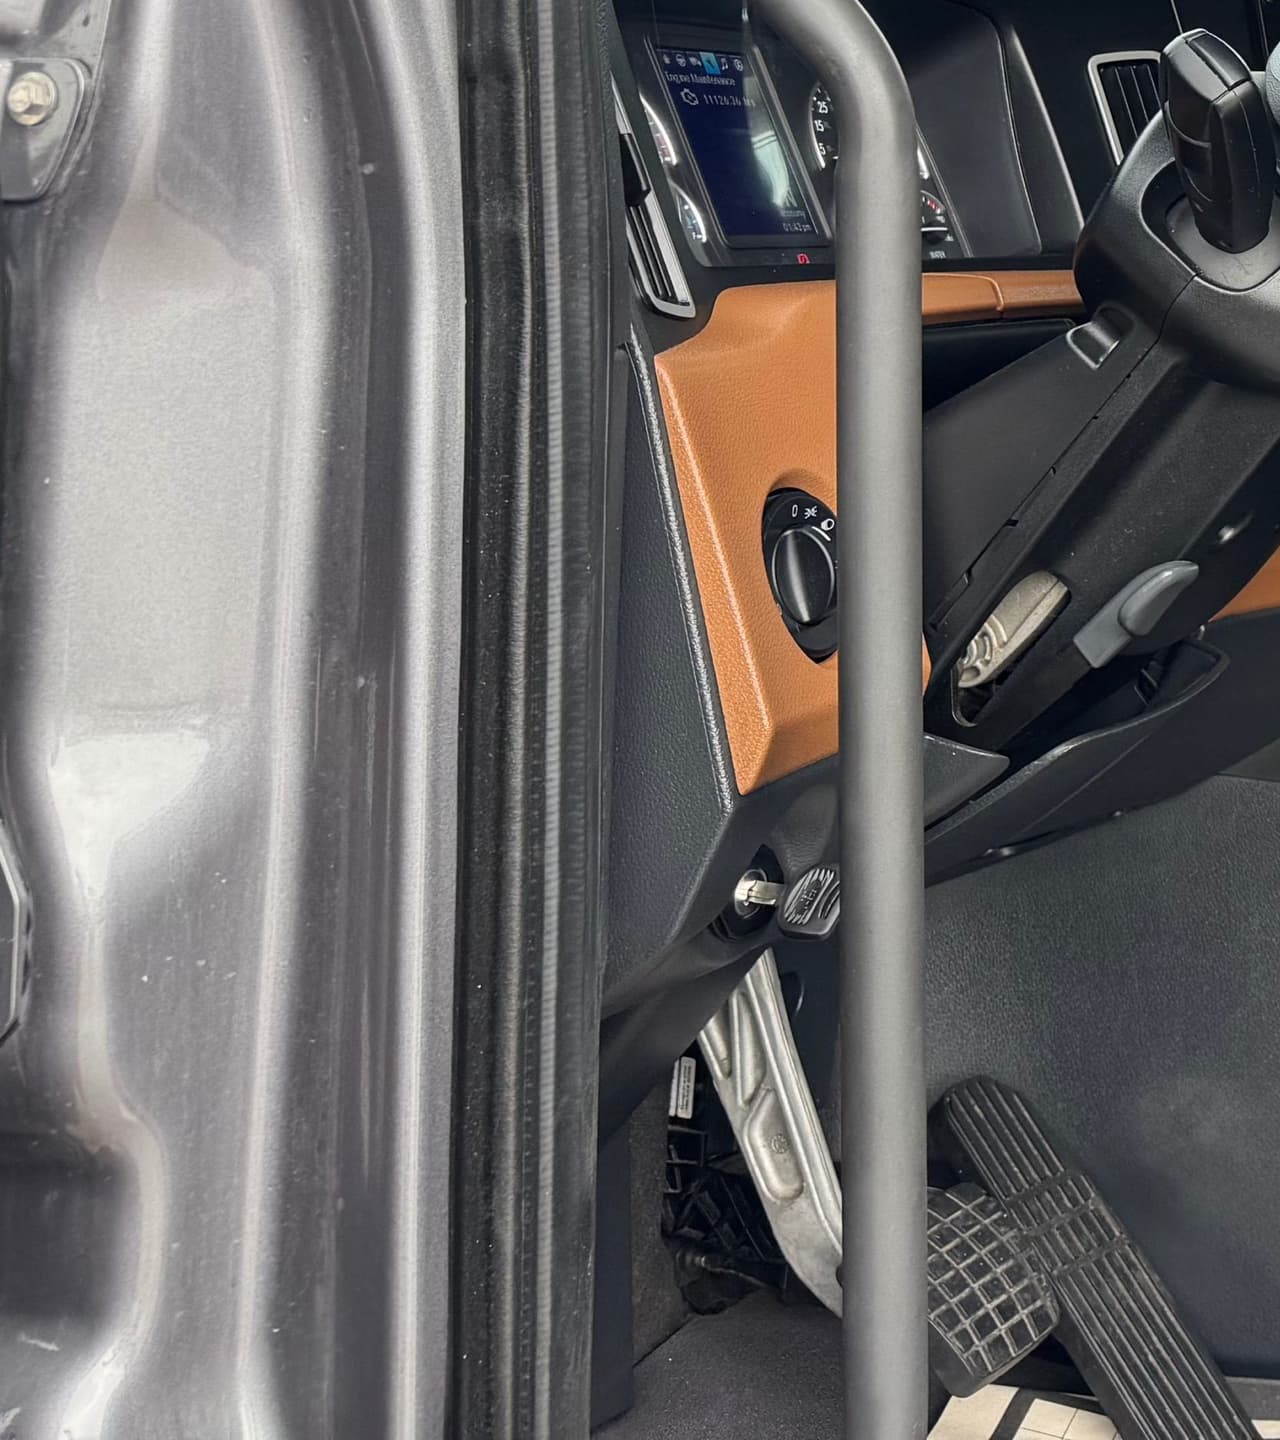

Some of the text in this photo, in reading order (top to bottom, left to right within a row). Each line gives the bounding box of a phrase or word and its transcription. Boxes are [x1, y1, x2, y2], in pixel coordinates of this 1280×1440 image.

[664, 71, 690, 84] Engine
[817, 101, 829, 114] 25
[814, 120, 825, 132] 15
